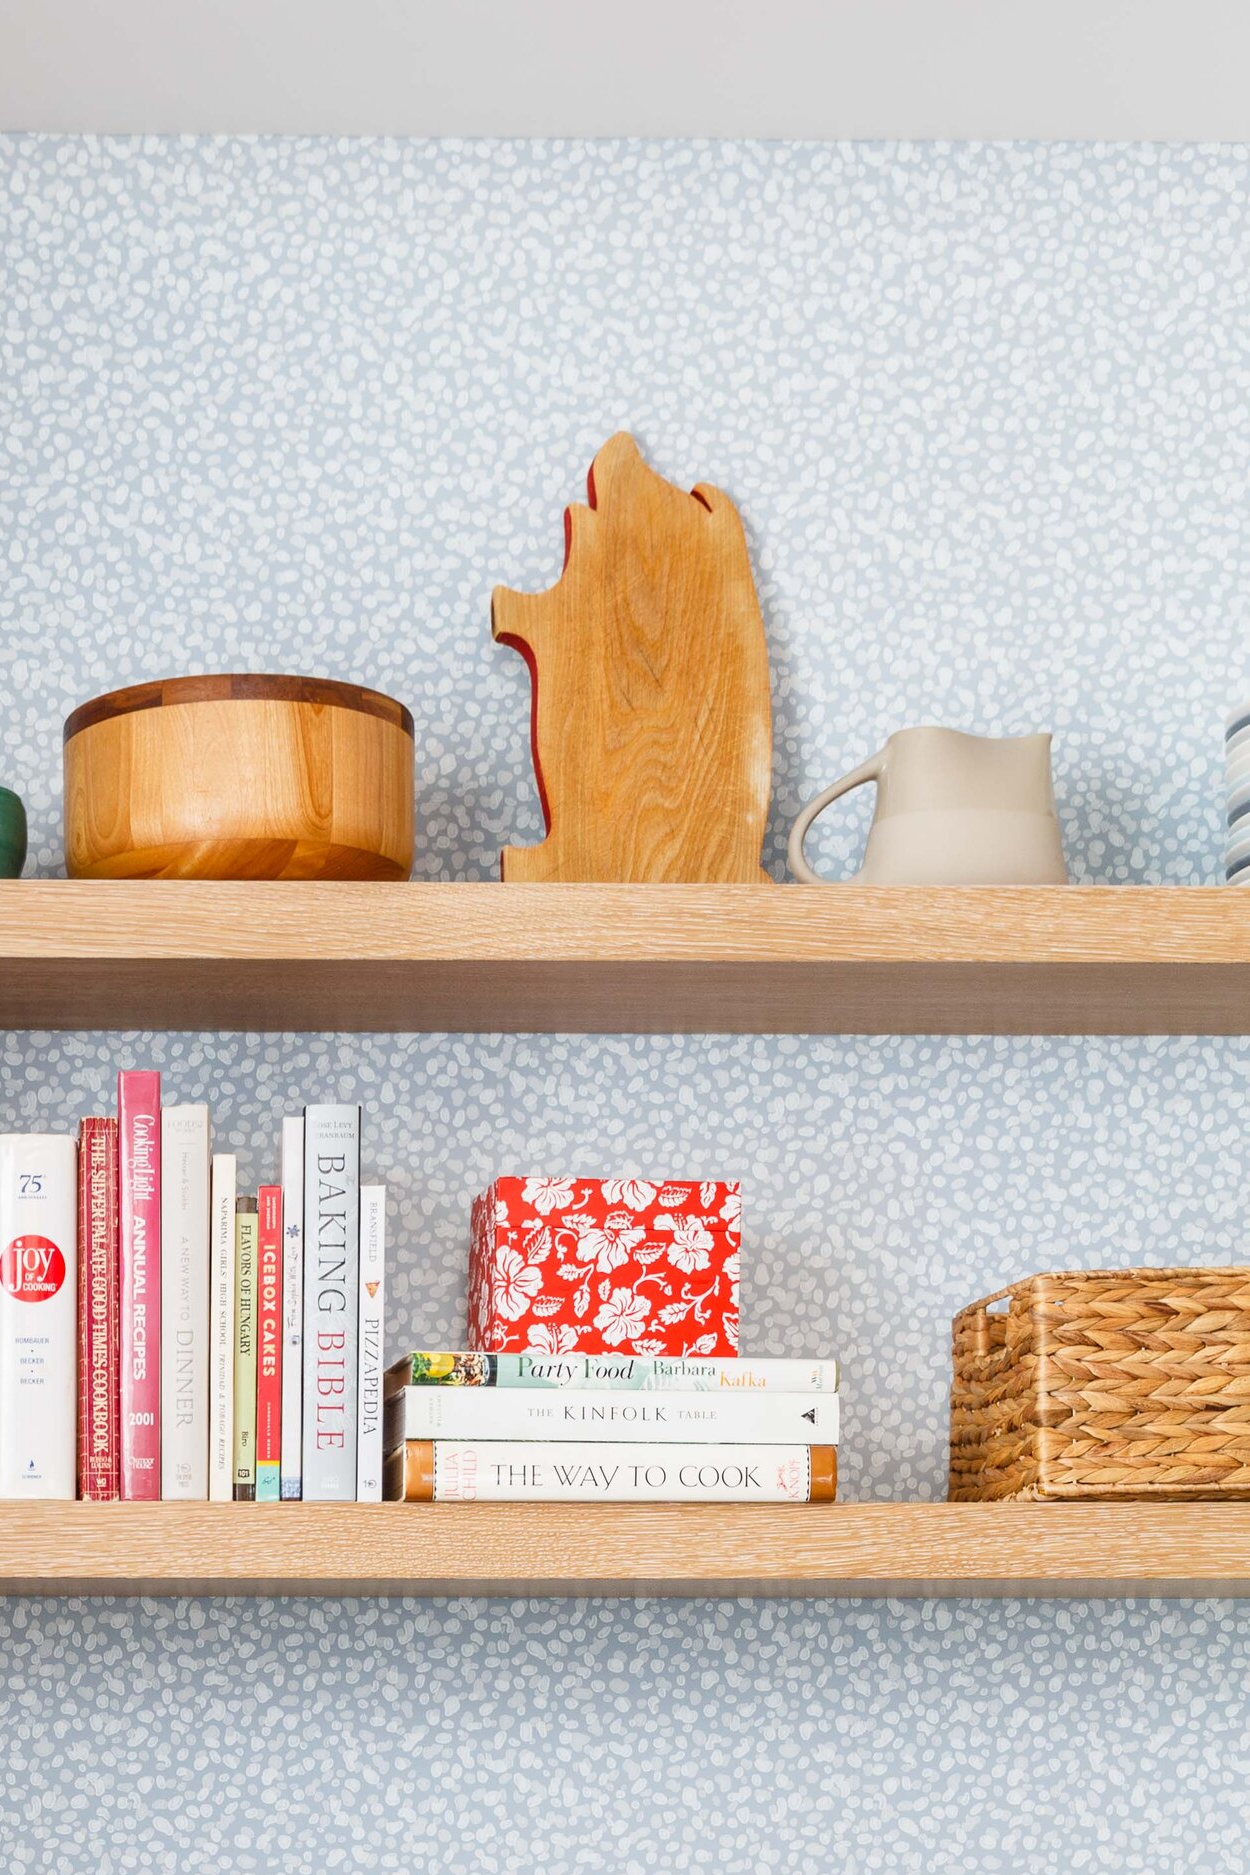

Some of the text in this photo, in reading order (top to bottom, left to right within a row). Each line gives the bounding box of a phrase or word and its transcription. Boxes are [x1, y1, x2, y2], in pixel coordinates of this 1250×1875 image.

[220, 1197, 228, 1245] NAPARIMA
[317, 1153, 347, 1313] BAKING
[369, 1202, 378, 1262] BRANSFIELD
[8, 1240, 55, 1293] joy
[23, 1282, 56, 1292] COOKING
[25, 1272, 35, 1280] OF
[239, 1224, 252, 1356] FLAVORS OF HUNGARY
[263, 1244, 277, 1312] ICEBOX
[91, 1136, 109, 1453] THE SILVER PALATE GOOD TIMES COOKBOOK
[133, 1216, 146, 1380] ANNUAL RECIPES
[176, 1236, 194, 1429] A NEW WAY TO DINNER
[262, 1318, 276, 1377] CAKES
[317, 1330, 346, 1450] BIBLE
[363, 1319, 380, 1435] PIZZAPEDIA
[518, 1356, 635, 1386] Party Food
[653, 1360, 716, 1376] Barbara
[719, 1370, 767, 1388] Kafka
[129, 1412, 154, 1426] 2001
[527, 1406, 717, 1421] THE KINFOLK TABLE
[241, 1431, 249, 1447] Biro
[444, 1452, 459, 1497] JULIA
[461, 1450, 477, 1500] CHILD
[490, 1464, 762, 1491] THE WAY TO COOK
[789, 1459, 801, 1499] KNOPF
